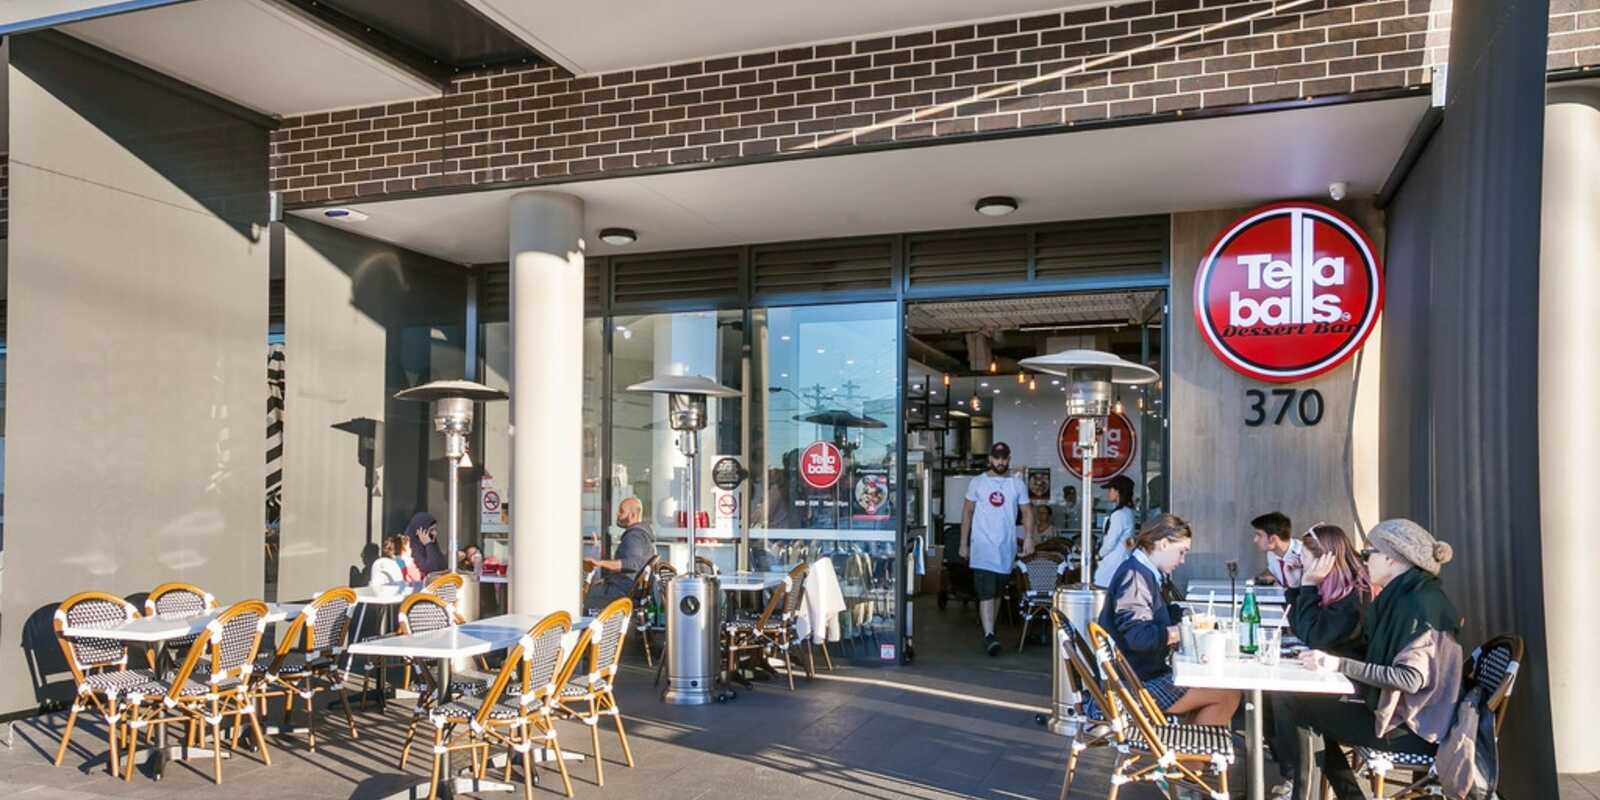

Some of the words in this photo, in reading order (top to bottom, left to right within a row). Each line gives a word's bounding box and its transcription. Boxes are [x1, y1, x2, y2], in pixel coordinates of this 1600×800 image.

[1237, 212, 1345, 290] Tella
[1223, 324, 1306, 338] Dessert
[1312, 322, 1357, 335] Bar
[1244, 388, 1325, 427] 370
